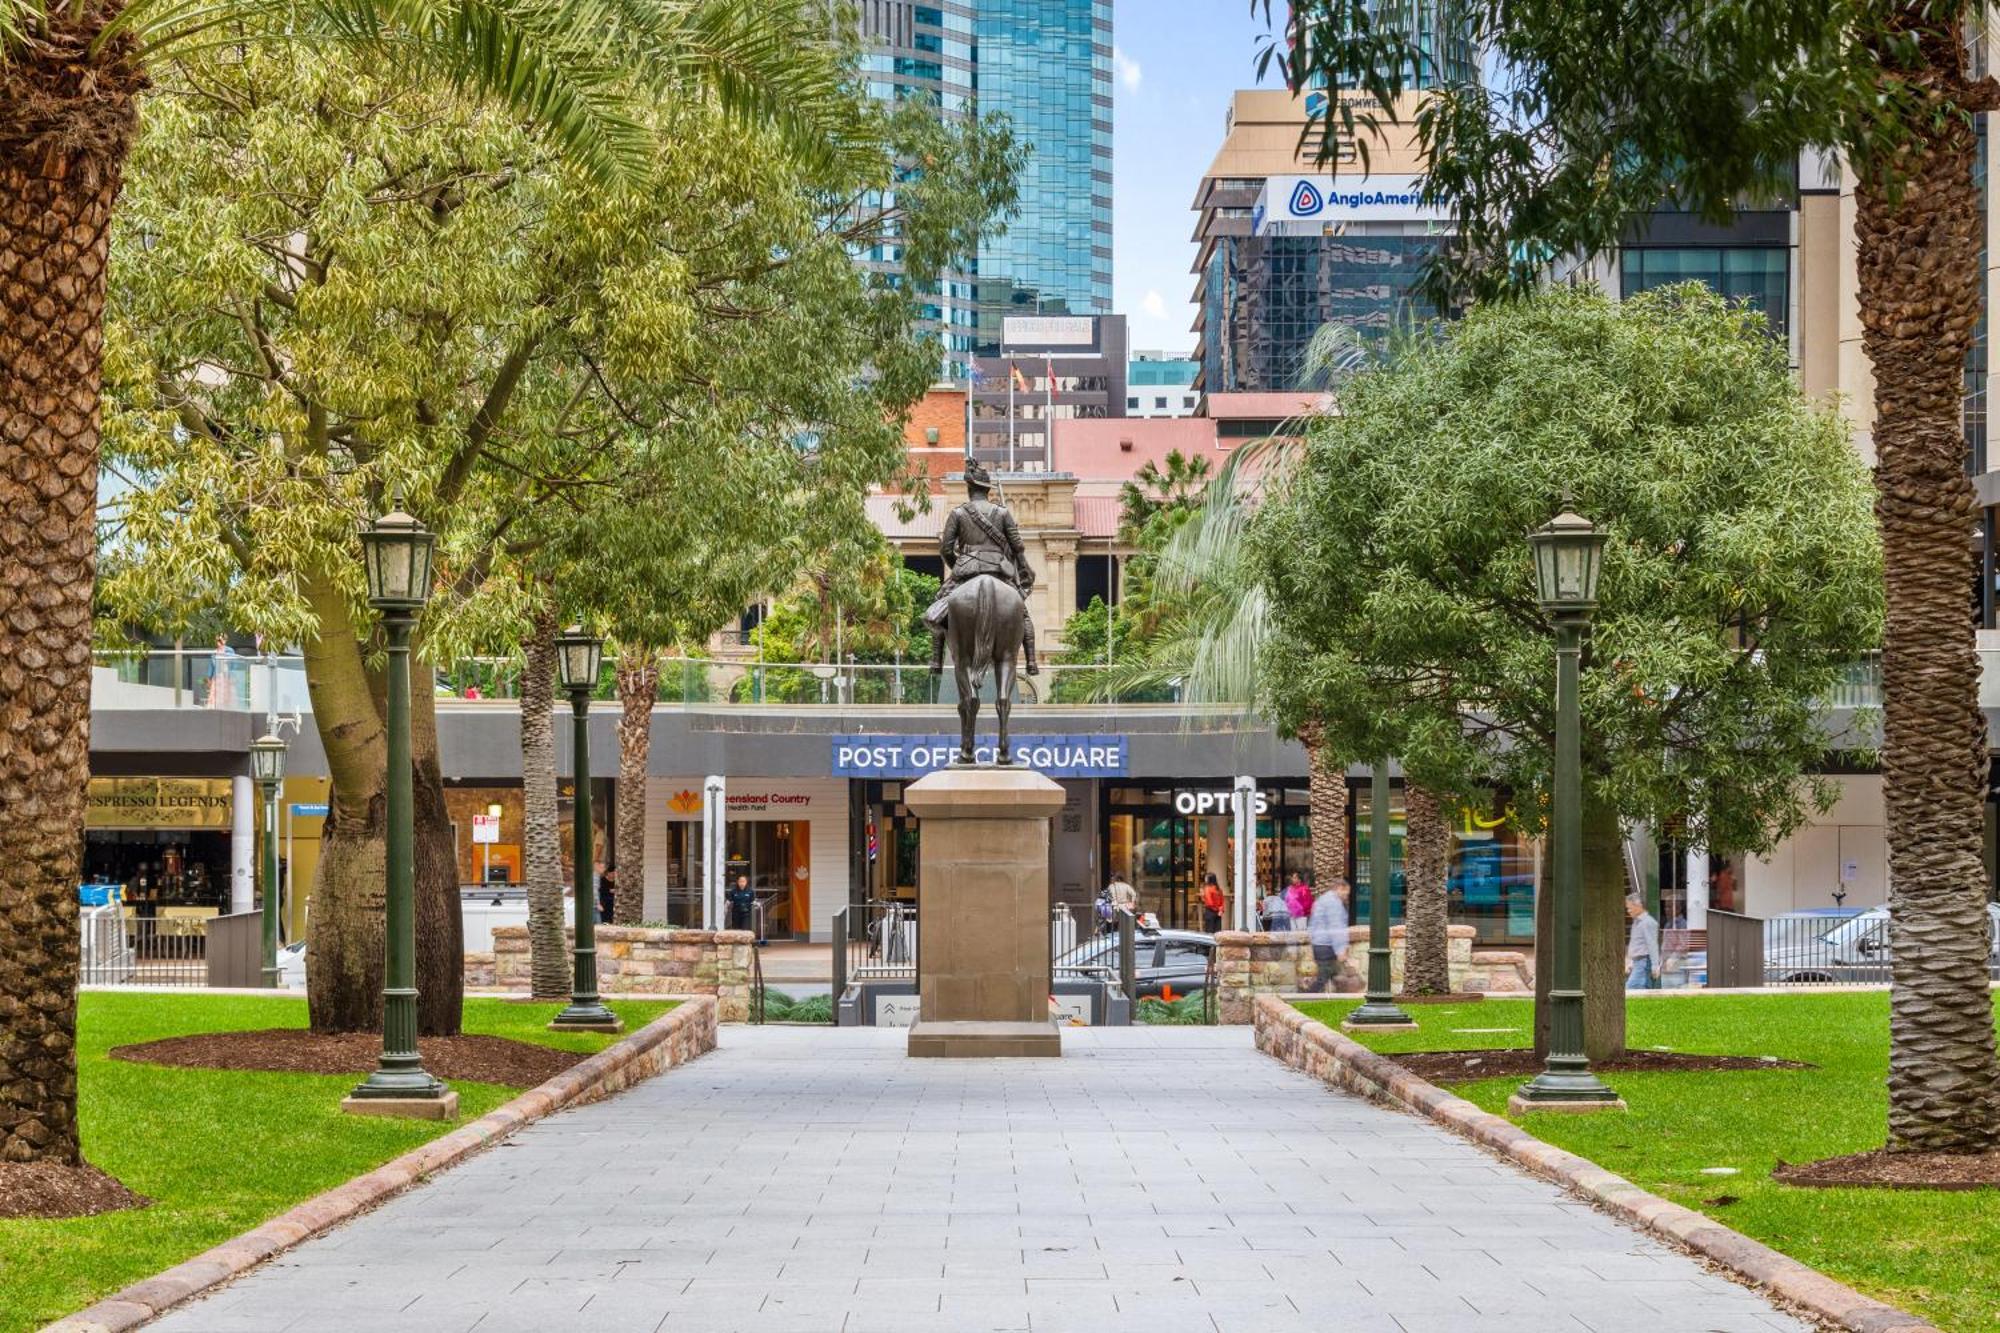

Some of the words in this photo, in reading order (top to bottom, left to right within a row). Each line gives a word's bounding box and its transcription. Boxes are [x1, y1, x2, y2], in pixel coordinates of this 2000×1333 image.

[1328, 191, 1446, 209] AngloAmeri
[839, 747, 902, 768] POST
[1016, 747, 1120, 768] SQUARE
[160, 796, 227, 807] LEGENDS
[771, 793, 811, 805] Country
[1176, 792, 1268, 814] OPTS
